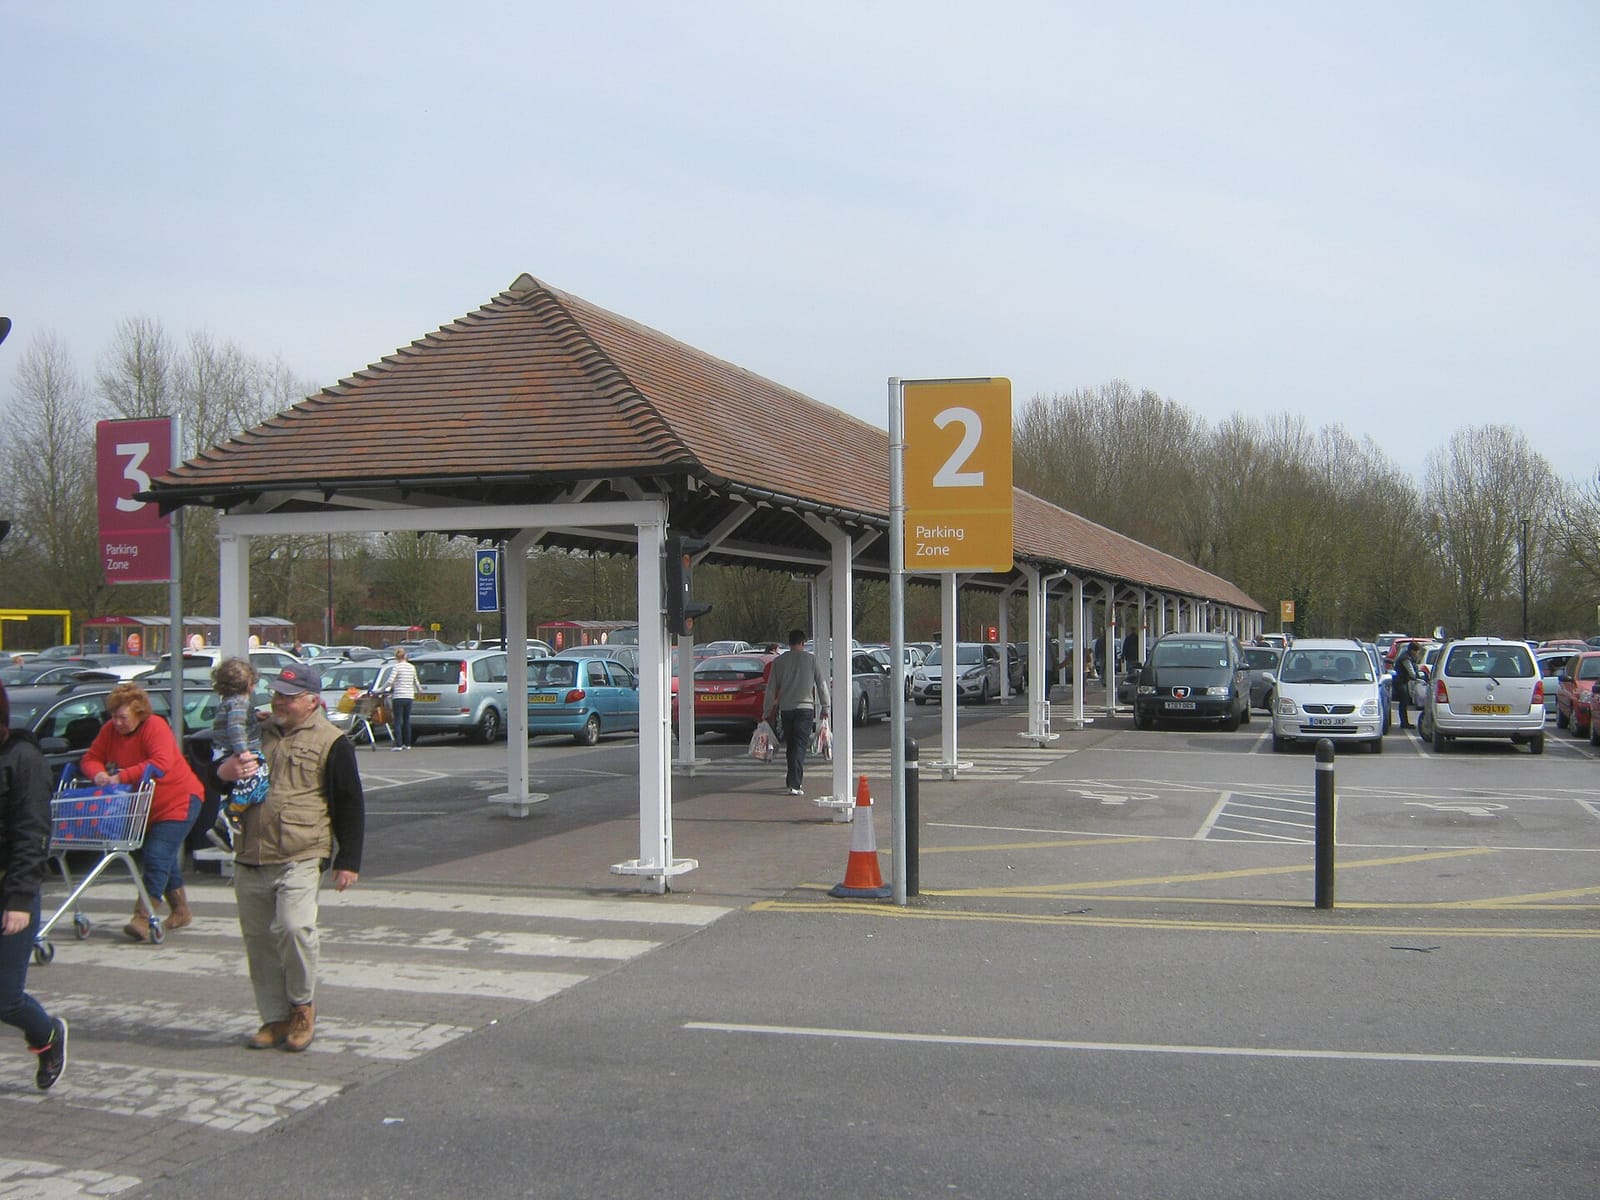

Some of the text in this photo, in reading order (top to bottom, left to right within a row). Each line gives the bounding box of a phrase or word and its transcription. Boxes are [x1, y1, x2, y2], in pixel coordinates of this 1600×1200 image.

[932, 406, 985, 488] 2
[115, 442, 152, 512] 3
[916, 525, 965, 540] Parking
[105, 544, 138, 556] Parking
[916, 543, 950, 556] Zone
[106, 559, 129, 570] Zone
[1285, 603, 1293, 613] 2
